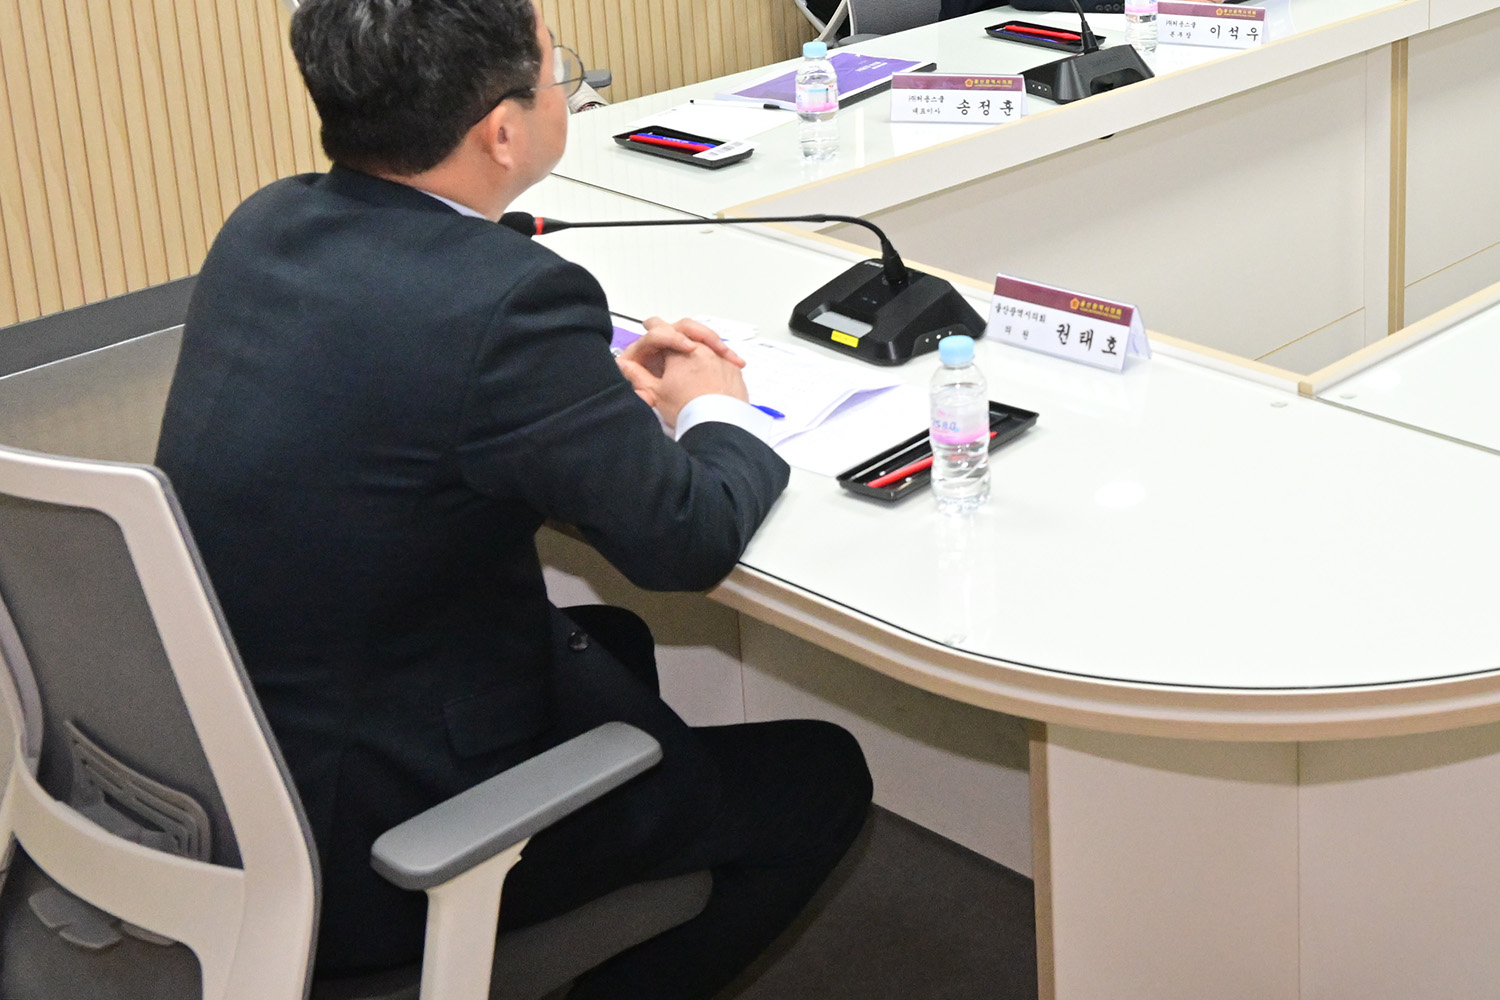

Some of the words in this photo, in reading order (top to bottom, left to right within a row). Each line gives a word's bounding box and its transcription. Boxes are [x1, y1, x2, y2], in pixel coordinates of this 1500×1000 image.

[1210, 25, 1259, 42] 이석우
[956, 99, 1014, 116] 송정훈
[995, 303, 1046, 323] 울산광역시의회
[1056, 323, 1117, 355] 권태호
